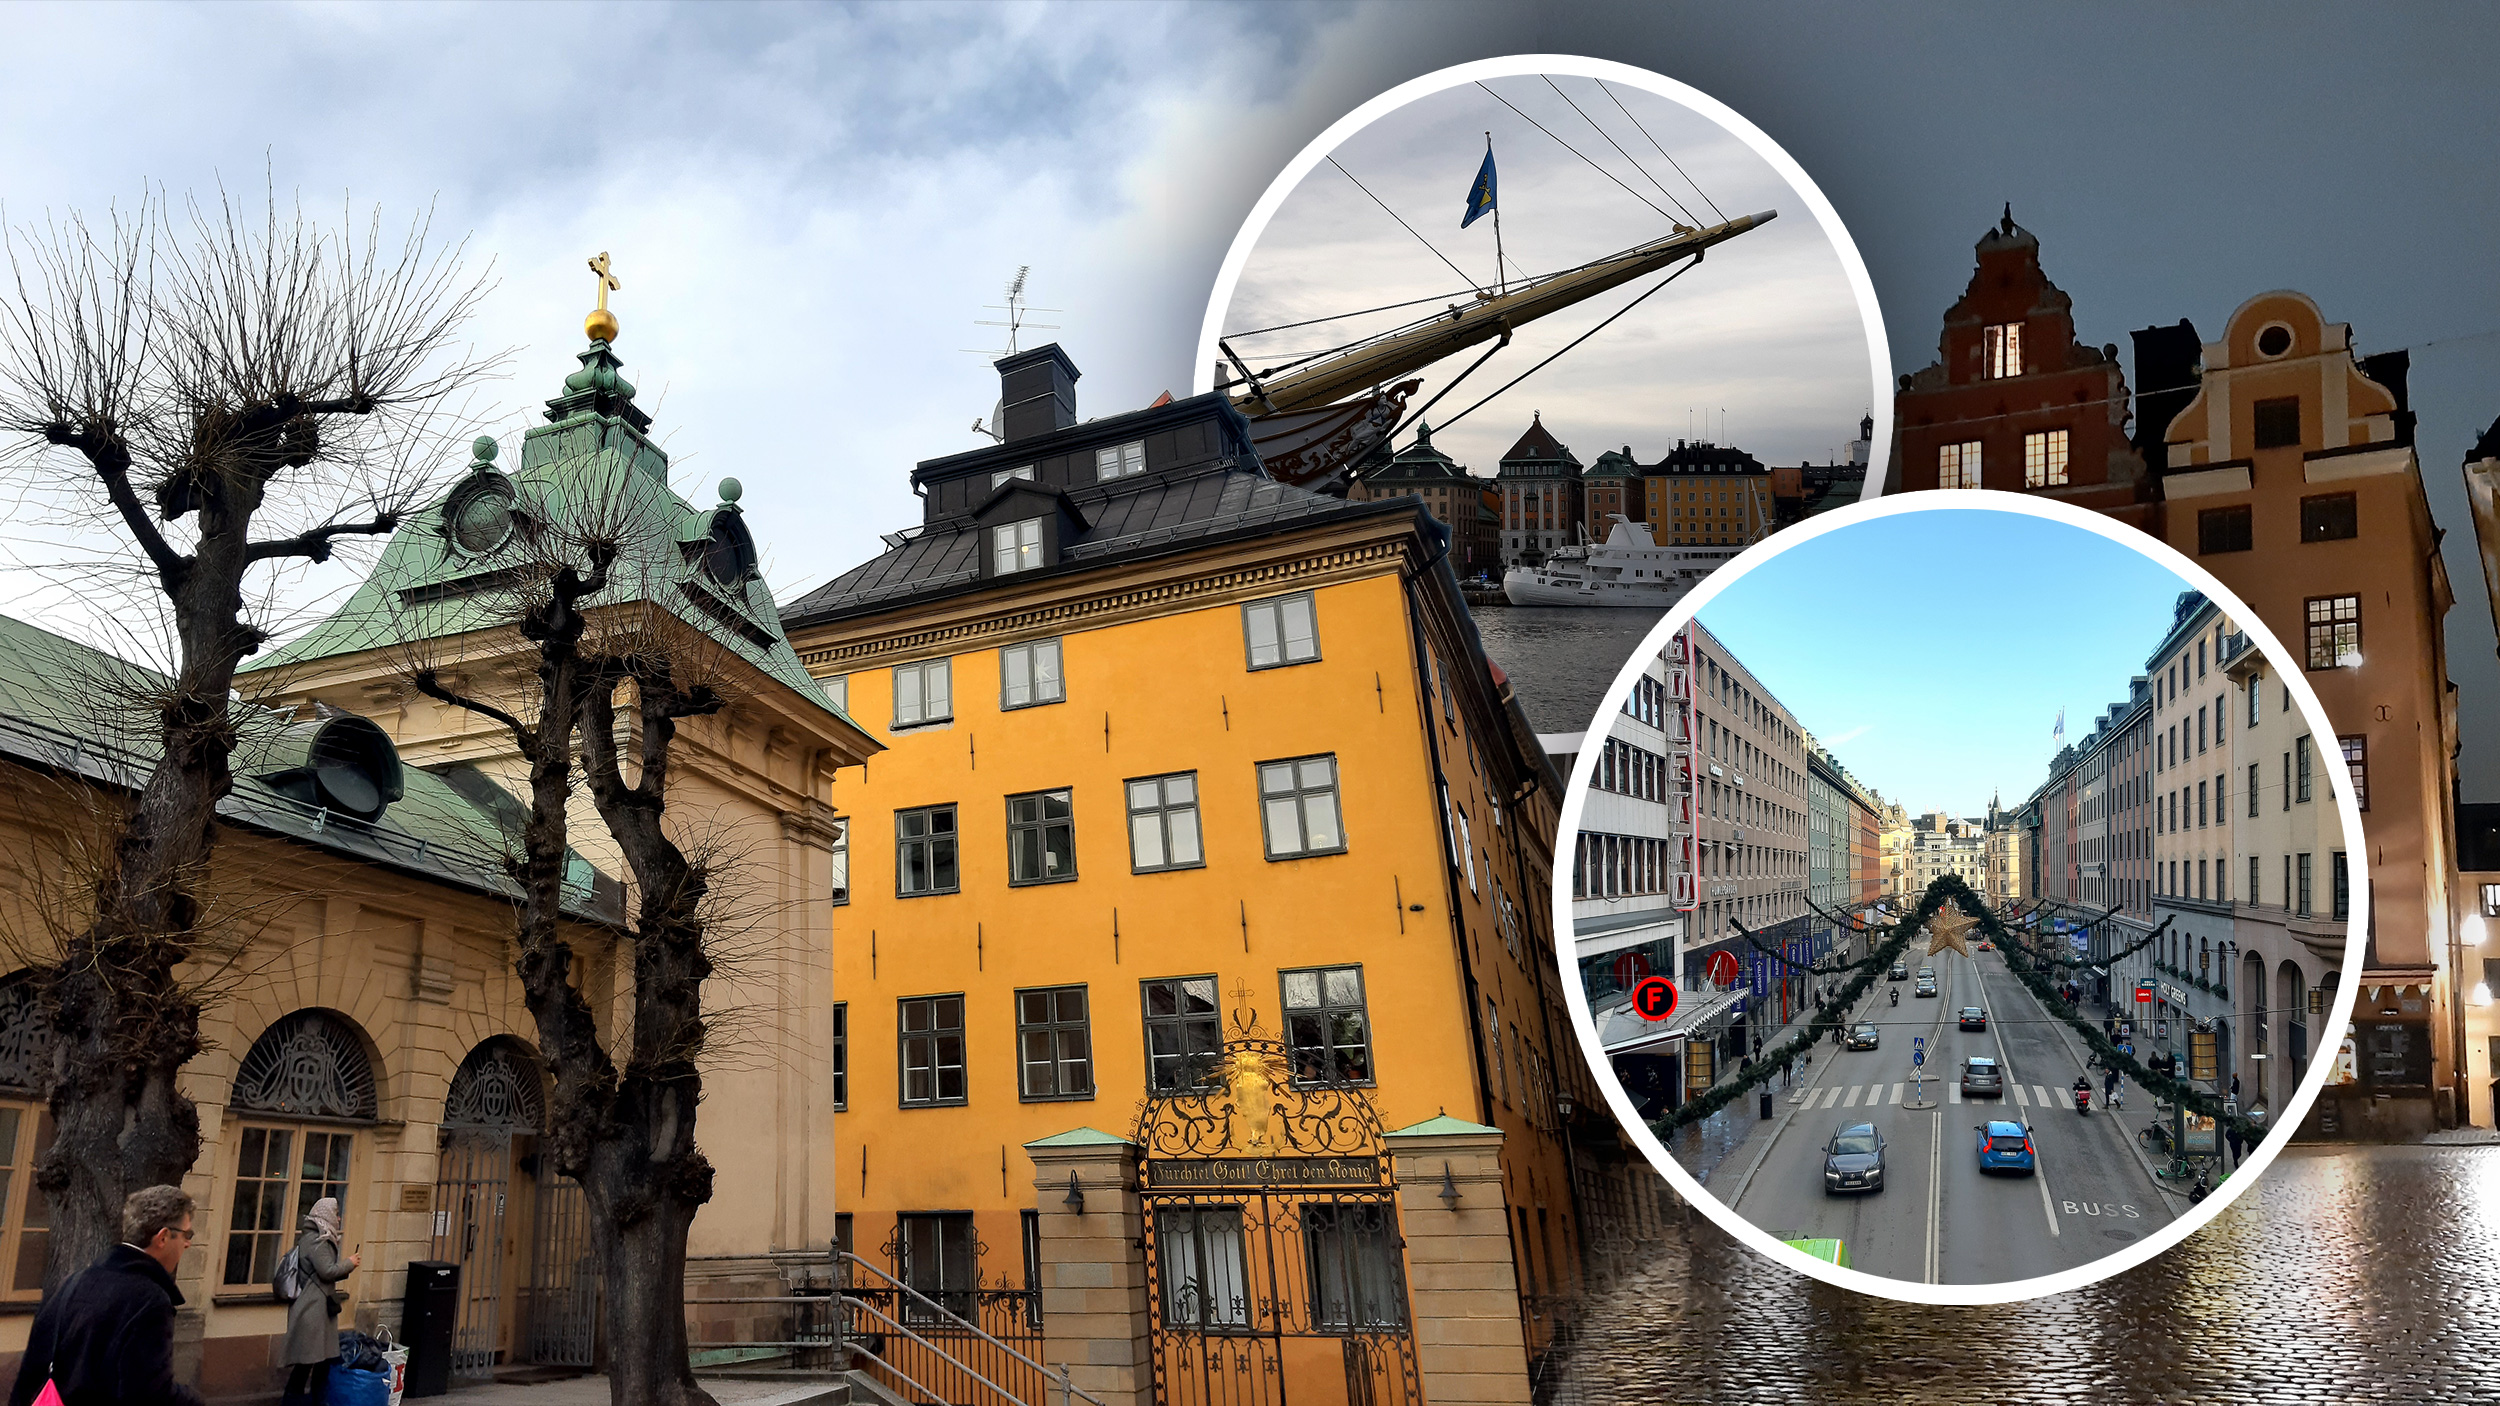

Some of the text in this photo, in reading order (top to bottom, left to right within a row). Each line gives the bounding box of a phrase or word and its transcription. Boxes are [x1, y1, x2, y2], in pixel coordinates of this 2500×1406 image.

[1647, 987, 1663, 1011] F
[2161, 981, 2186, 1006] HOLY GREENS
[1154, 1159, 1375, 1183] Fürchtet Gott! Ehret den König!
[2062, 1200, 2140, 1219] BUSS
